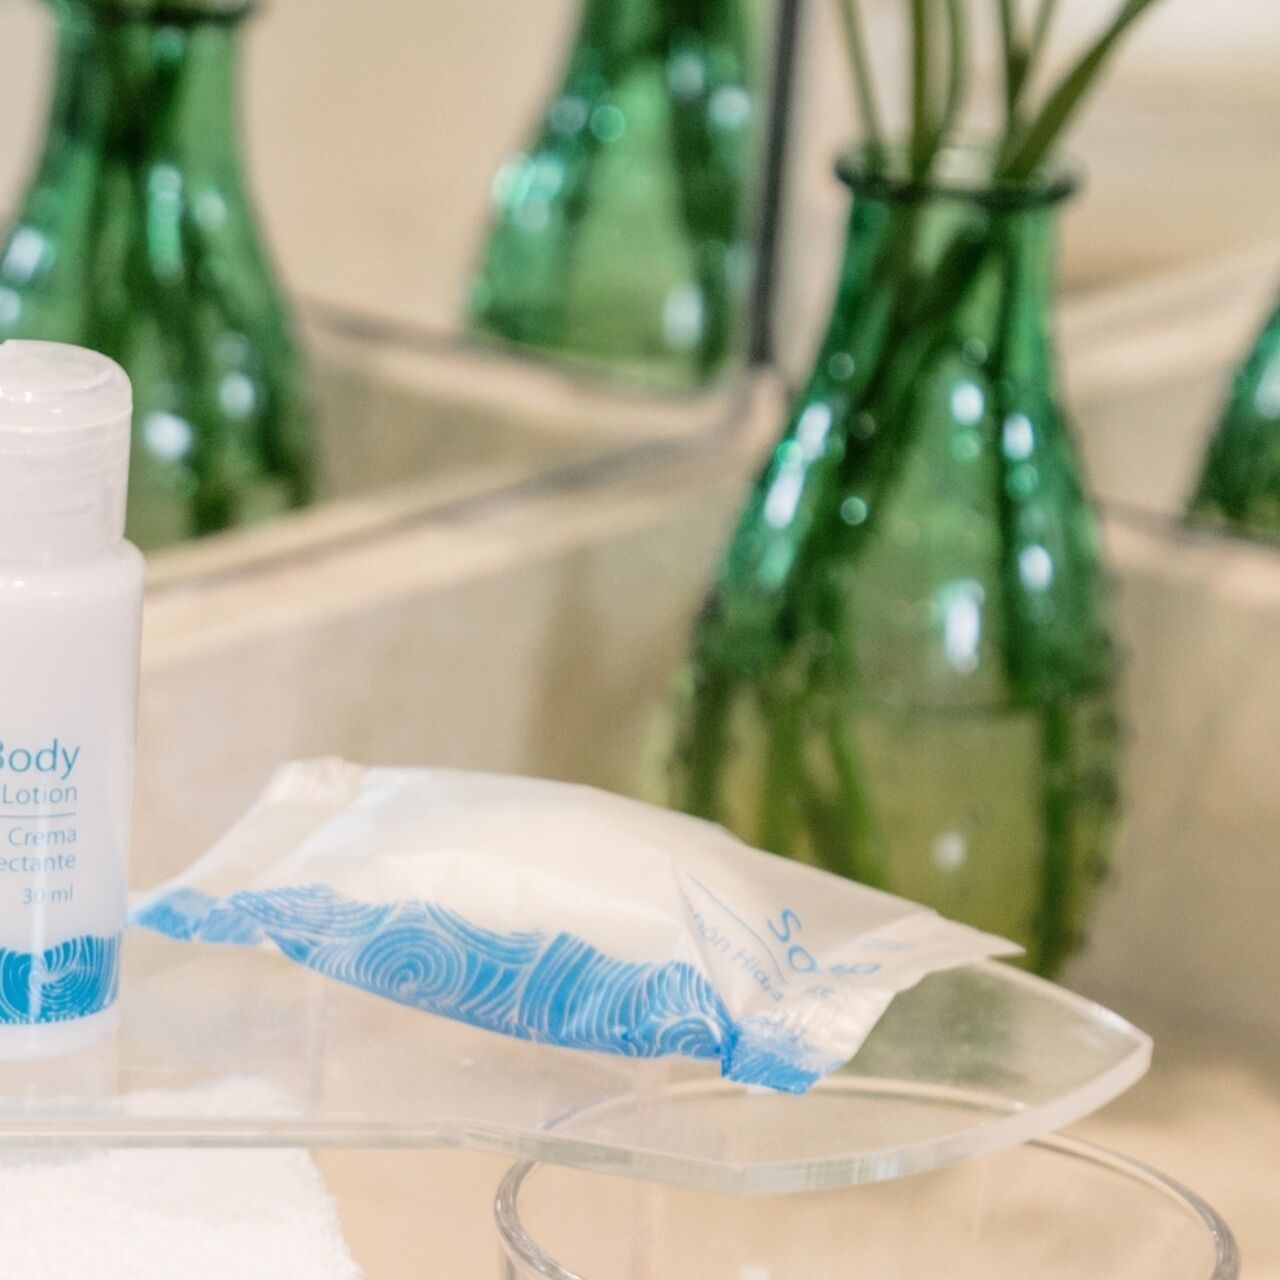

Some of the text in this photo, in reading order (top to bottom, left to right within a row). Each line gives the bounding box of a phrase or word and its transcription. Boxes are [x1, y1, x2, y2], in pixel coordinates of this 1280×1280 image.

[2, 783, 79, 804] Lotion
[8, 826, 77, 846] Crema
[22, 883, 74, 905] 30 ml
